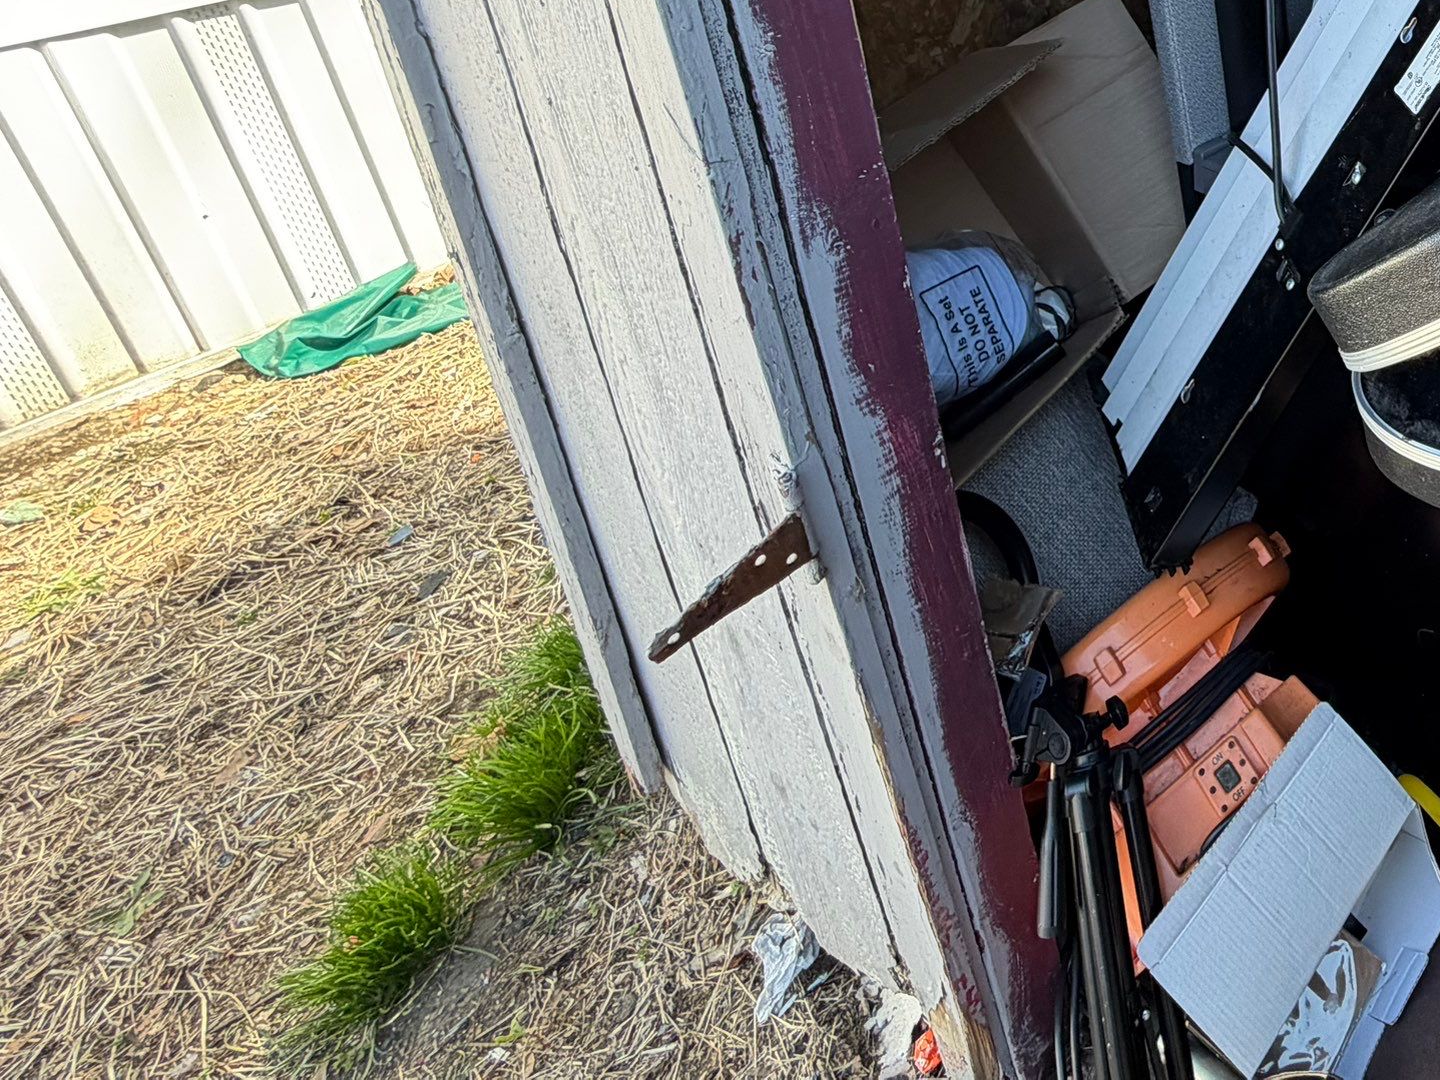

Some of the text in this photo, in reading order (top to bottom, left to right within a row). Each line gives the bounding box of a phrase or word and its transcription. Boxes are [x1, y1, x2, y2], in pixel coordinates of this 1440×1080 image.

[938, 295, 978, 389] This Is A Set
[958, 306, 990, 363] DO NOT
[970, 286, 1006, 365] SEPARATE
[1212, 752, 1223, 765] ON
[1233, 786, 1245, 801] OFF
